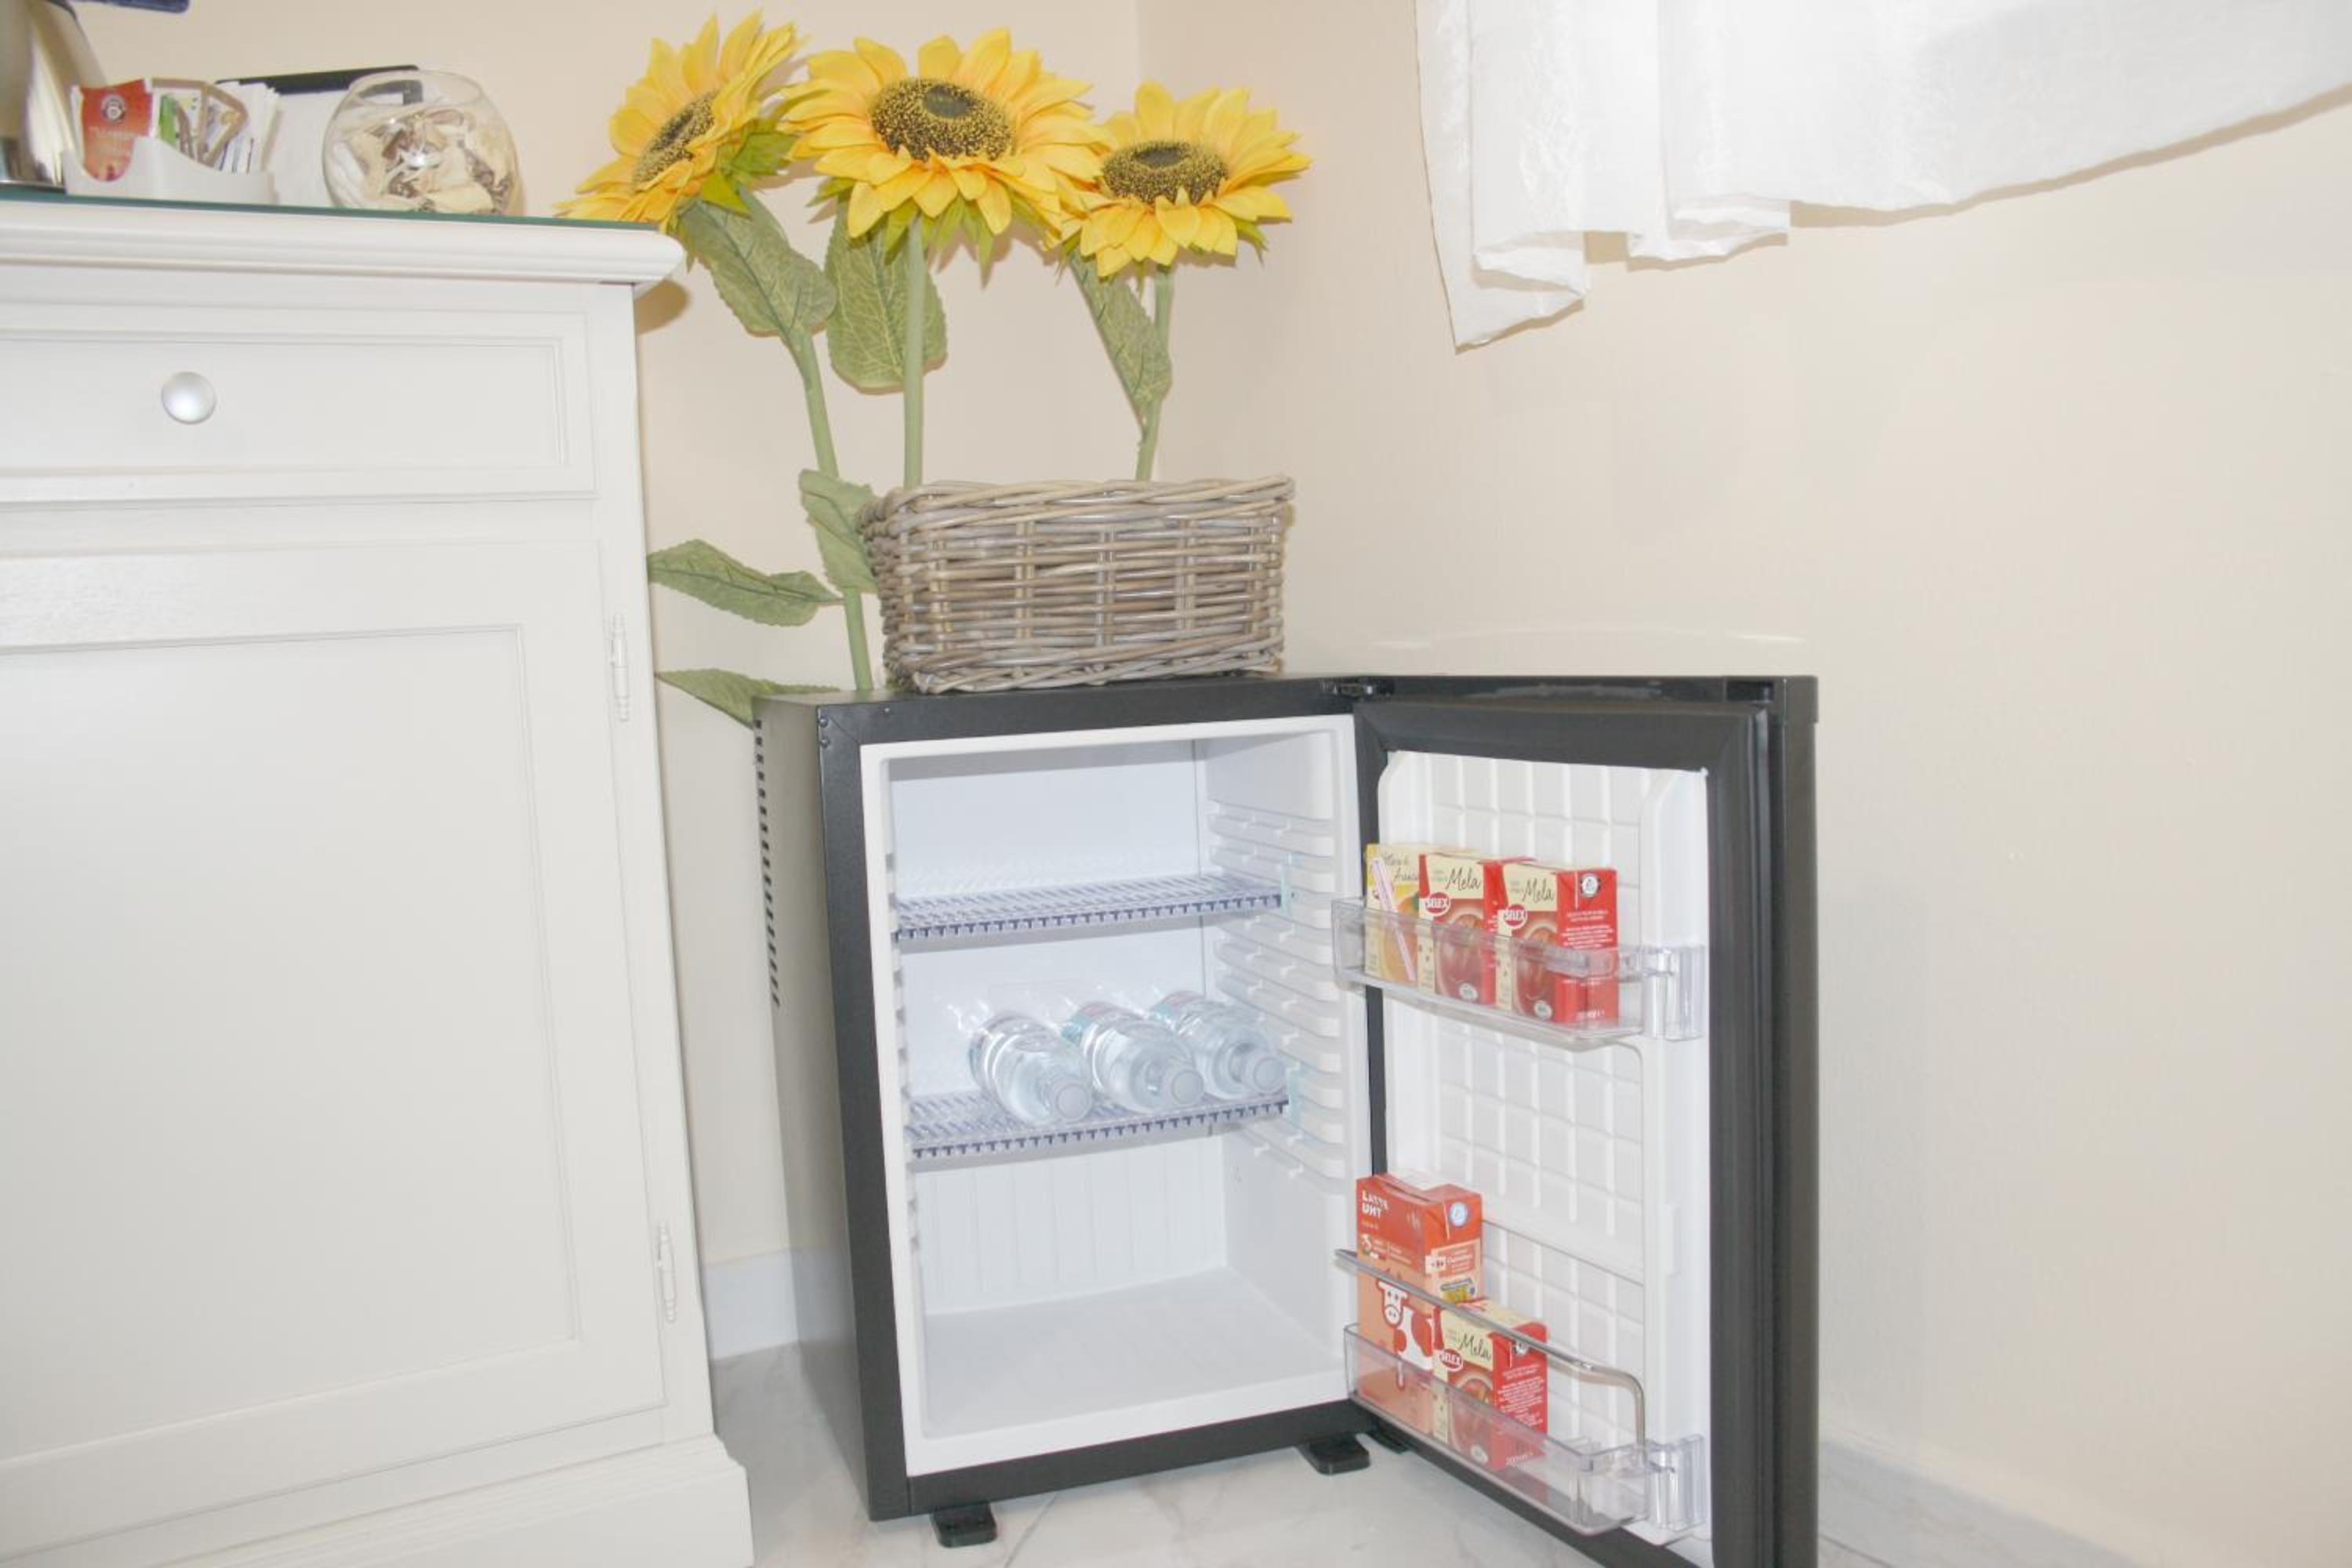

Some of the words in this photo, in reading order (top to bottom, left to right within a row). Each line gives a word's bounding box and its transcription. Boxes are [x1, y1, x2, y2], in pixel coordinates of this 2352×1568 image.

[1446, 866, 1482, 891] Mela
[1523, 877, 1555, 903] Mela
[1362, 1190, 1388, 1210] LATTE
[1362, 1202, 1381, 1218] UHT
[1460, 1333, 1492, 1361] Mela
